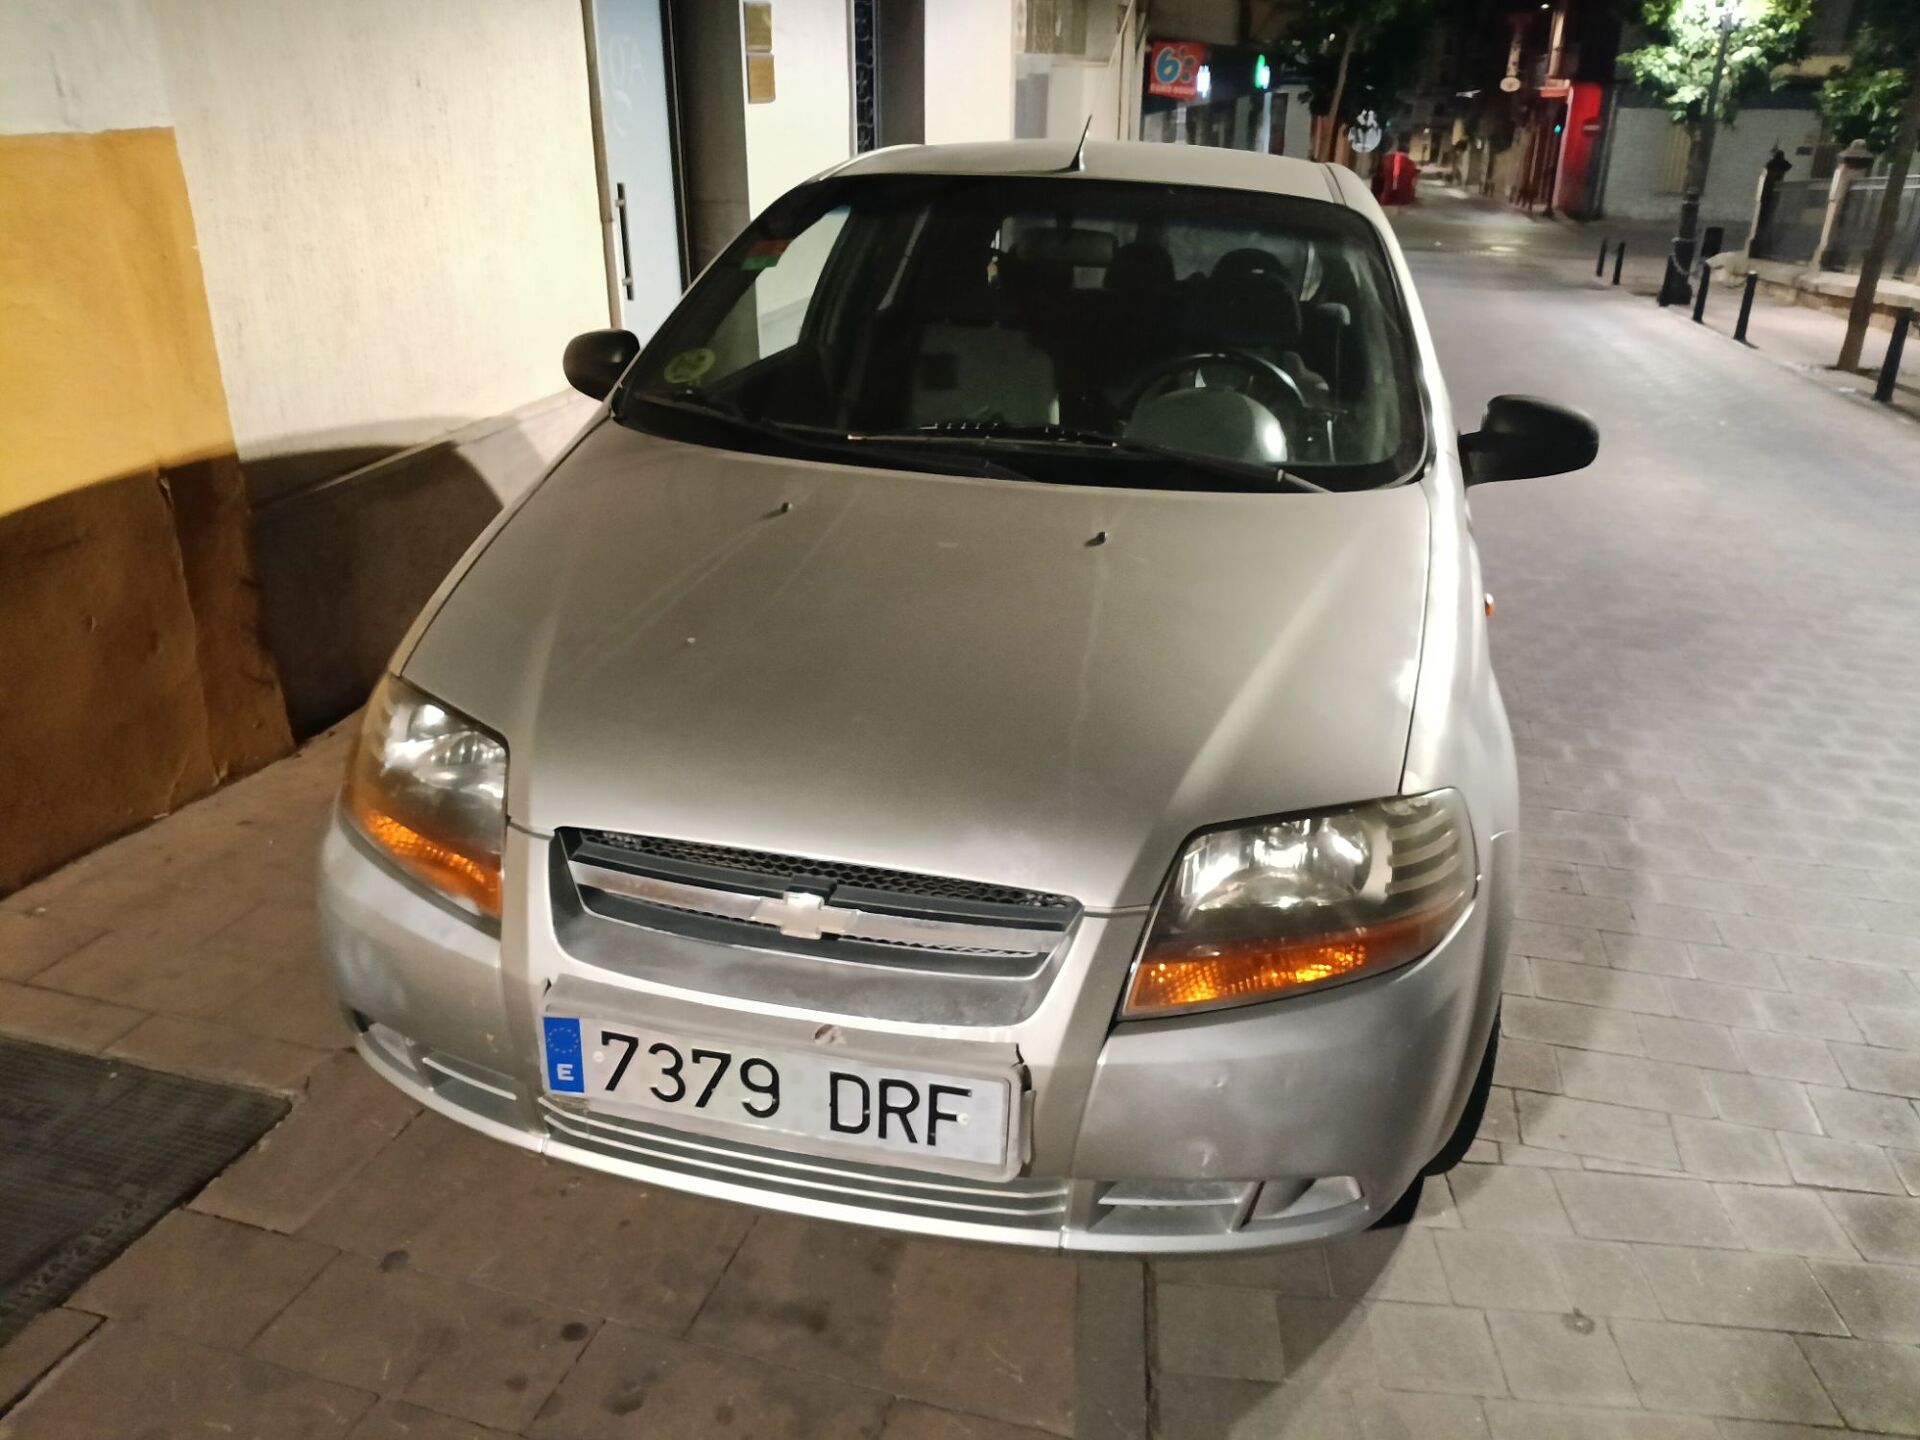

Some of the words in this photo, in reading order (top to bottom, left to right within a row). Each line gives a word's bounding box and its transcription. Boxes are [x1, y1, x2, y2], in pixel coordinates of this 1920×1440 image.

[557, 1063, 575, 1081] E
[600, 1030, 781, 1119] 7379
[829, 1070, 973, 1147] DRF
